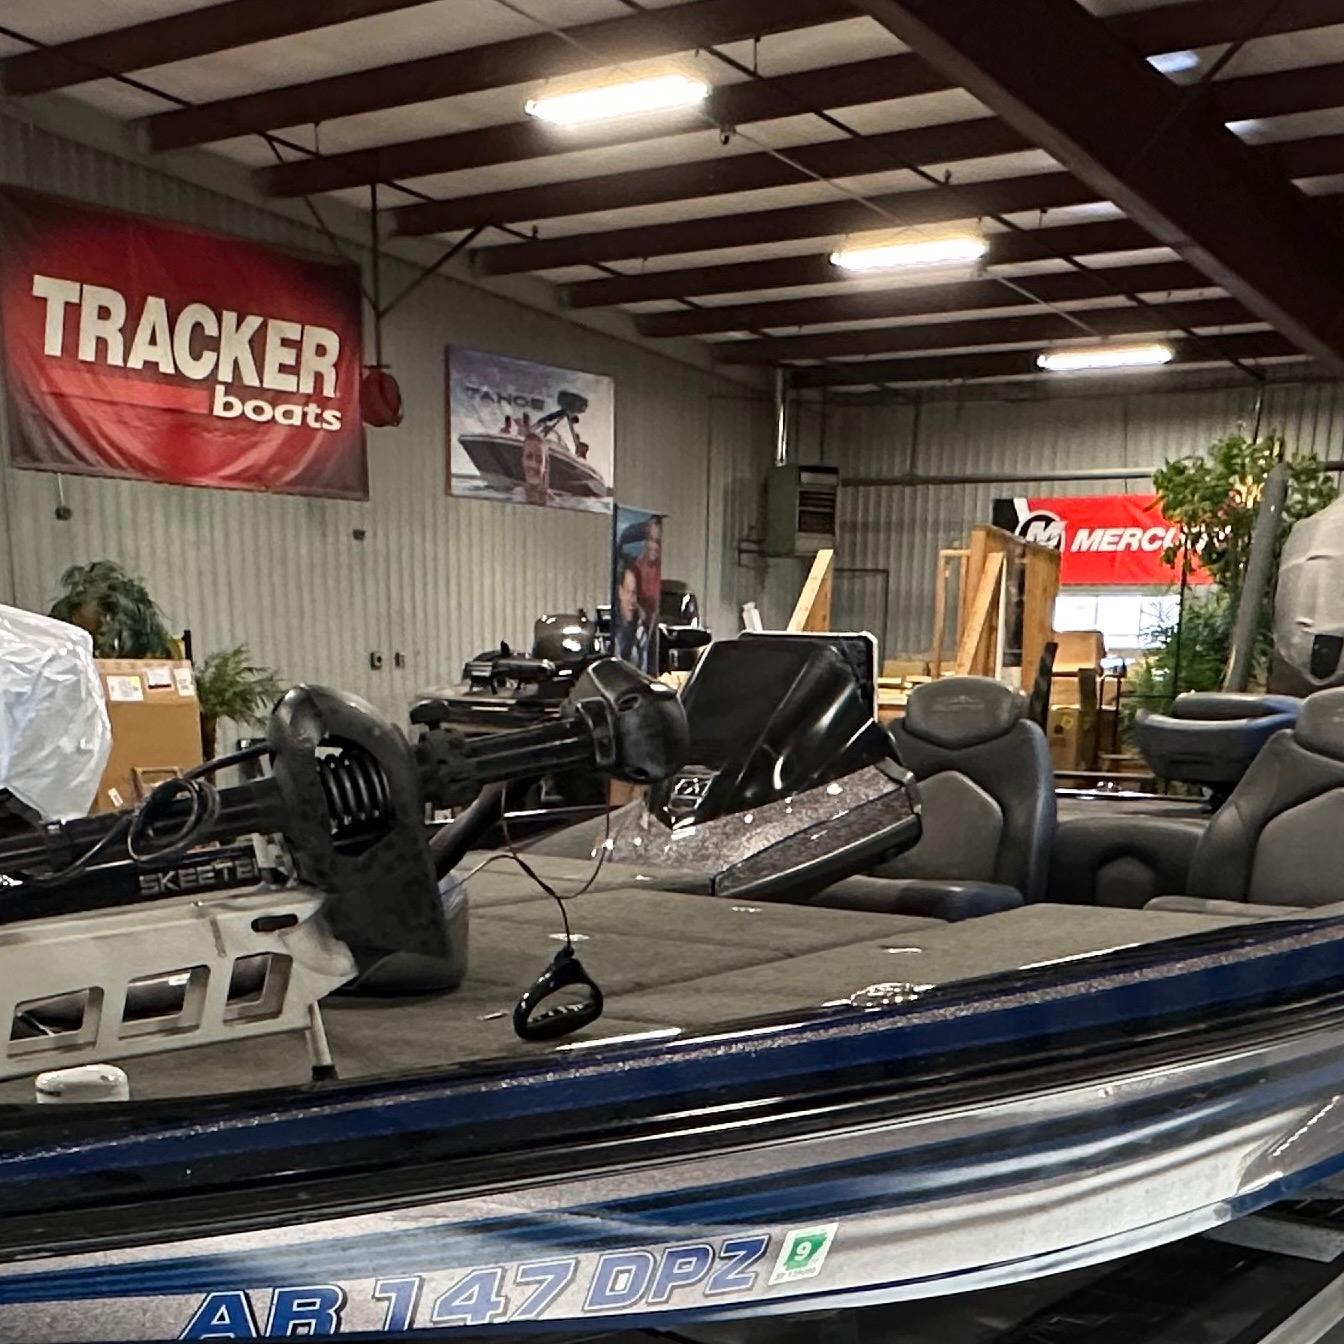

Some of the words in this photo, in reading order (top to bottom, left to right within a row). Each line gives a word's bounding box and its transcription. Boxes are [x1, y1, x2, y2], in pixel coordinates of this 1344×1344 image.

[32, 274, 340, 398] TRACKER
[212, 384, 342, 431] boats
[179, 1283, 345, 1340] AR
[373, 1258, 577, 1332] 147
[582, 1233, 771, 1313] DPZ
[795, 1241, 812, 1261] 9
